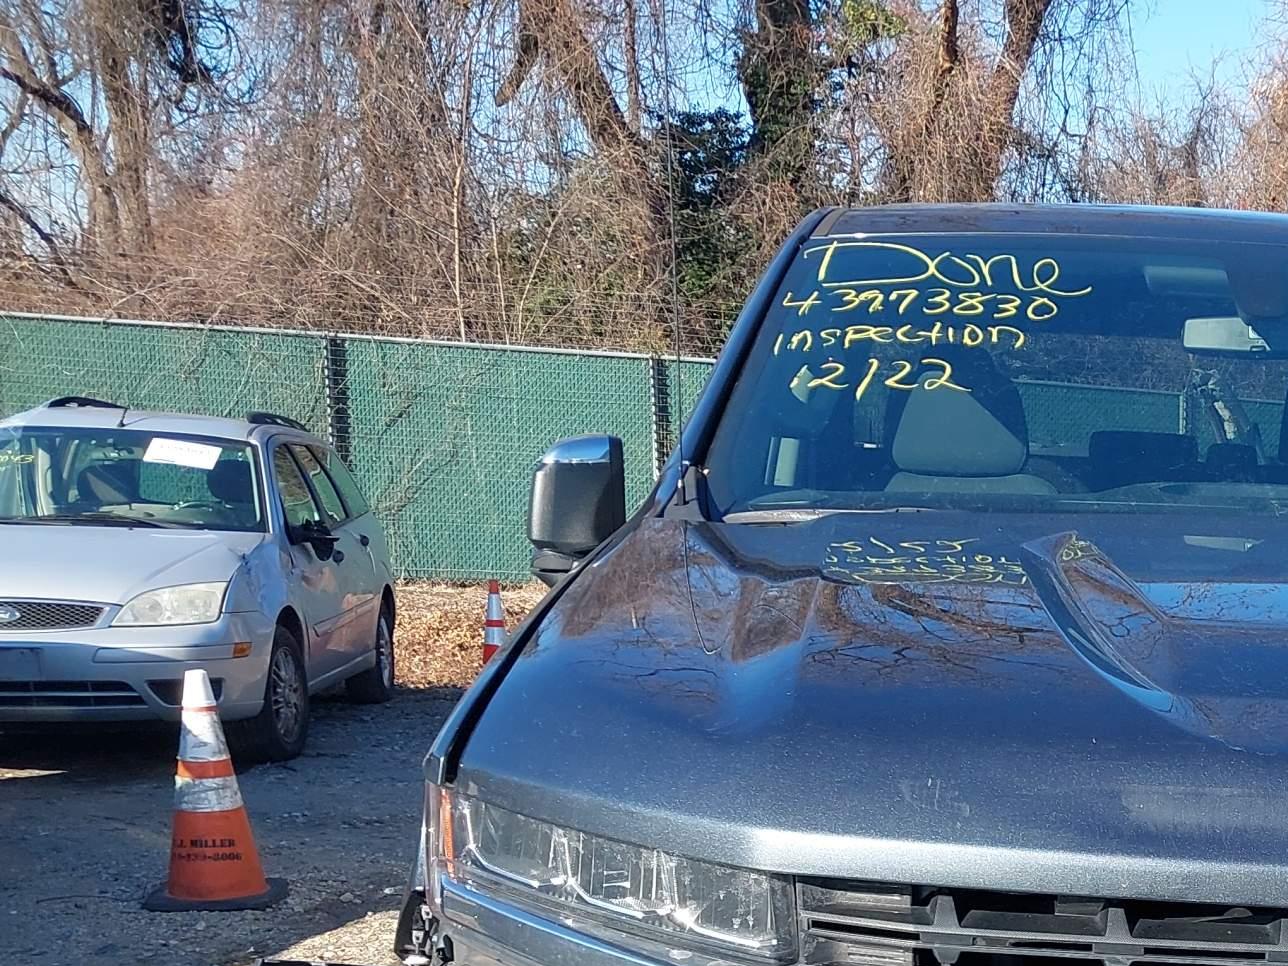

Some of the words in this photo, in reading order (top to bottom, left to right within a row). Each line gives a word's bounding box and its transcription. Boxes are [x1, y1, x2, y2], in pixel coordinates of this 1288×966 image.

[803, 240, 1092, 295] Done
[782, 288, 1058, 320] 43973830
[789, 357, 973, 401] 12/22
